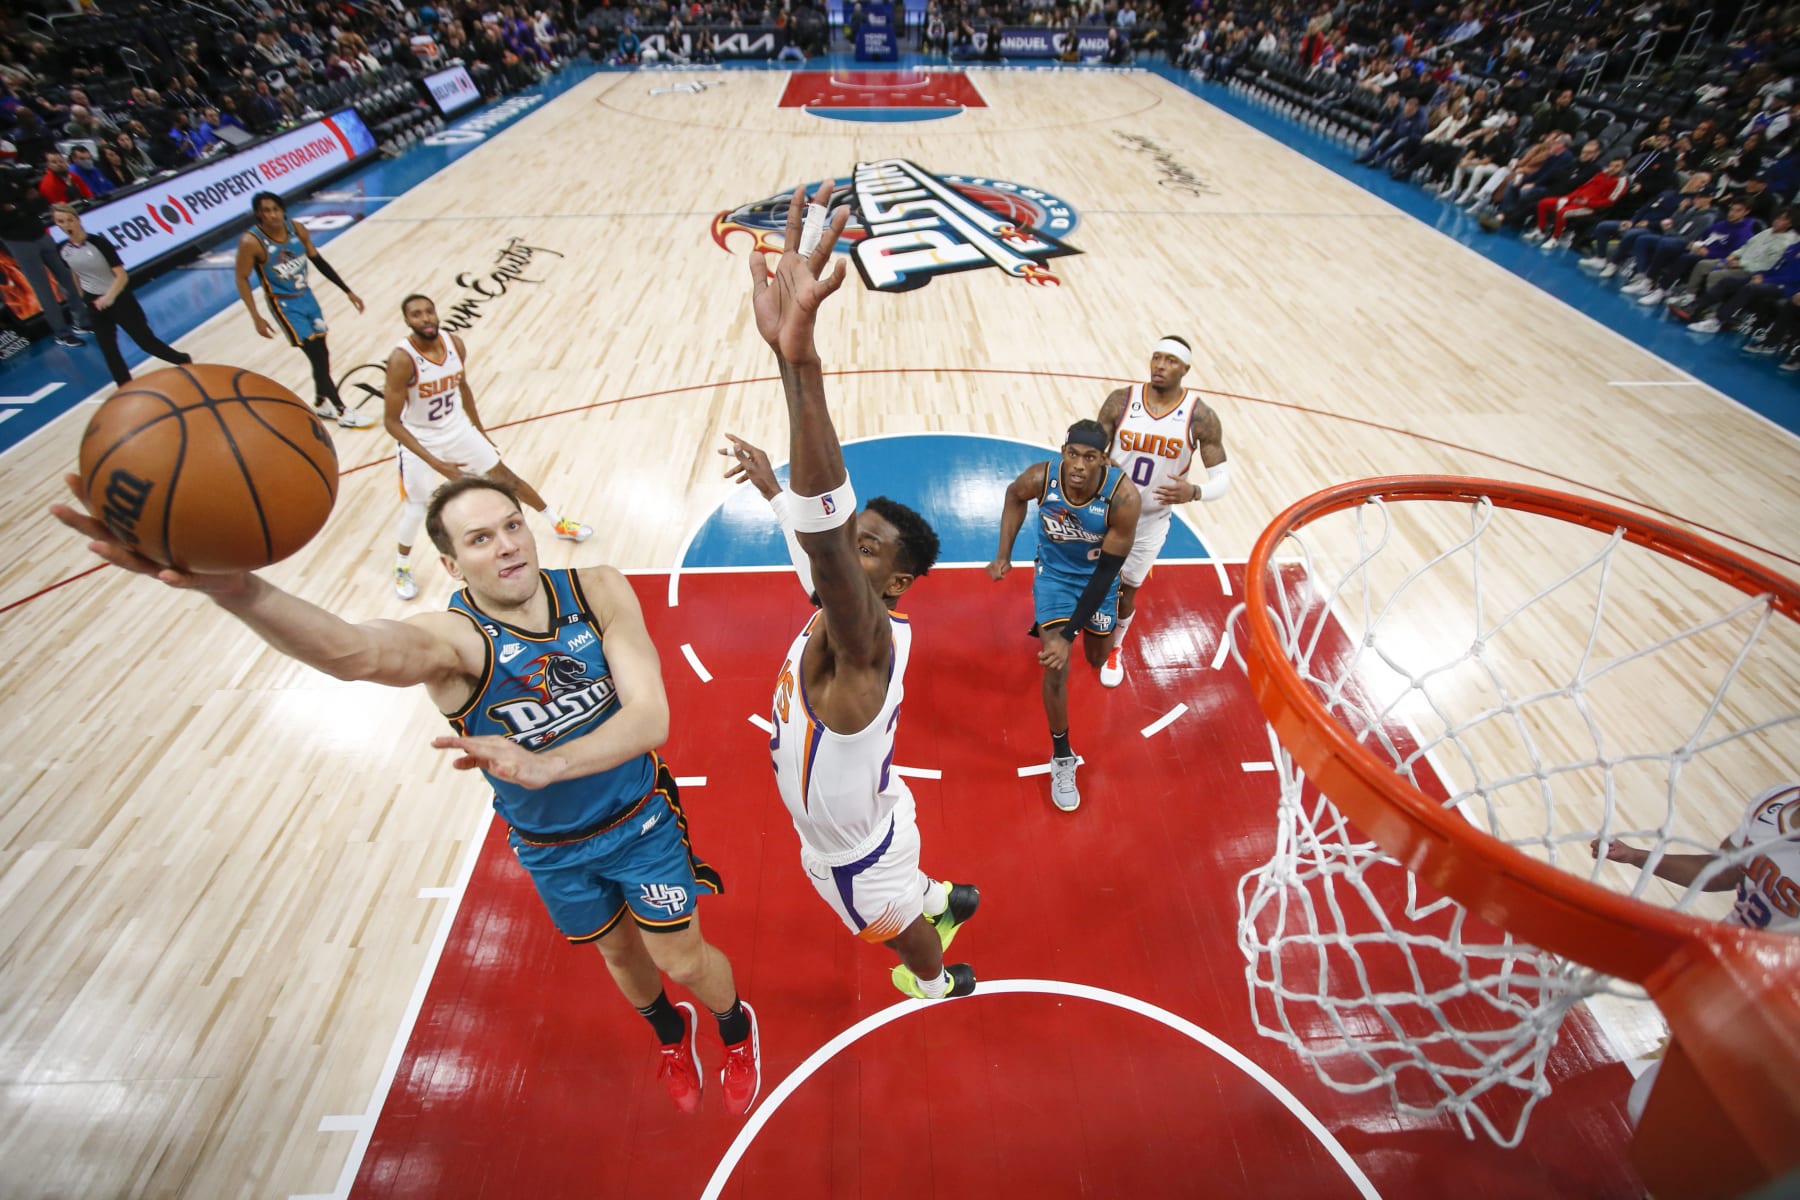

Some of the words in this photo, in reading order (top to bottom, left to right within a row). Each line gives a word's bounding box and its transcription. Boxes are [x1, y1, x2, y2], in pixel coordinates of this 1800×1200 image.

[1000, 37, 1048, 49] ANDUEL
[183, 168, 262, 215] PROPERTY
[258, 135, 337, 181] RESTORATION
[428, 391, 456, 422] 25
[1119, 429, 1184, 460] SUNS
[1131, 456, 1155, 487] 0
[567, 613, 579, 624] 16
[494, 678, 616, 733] PISTO
